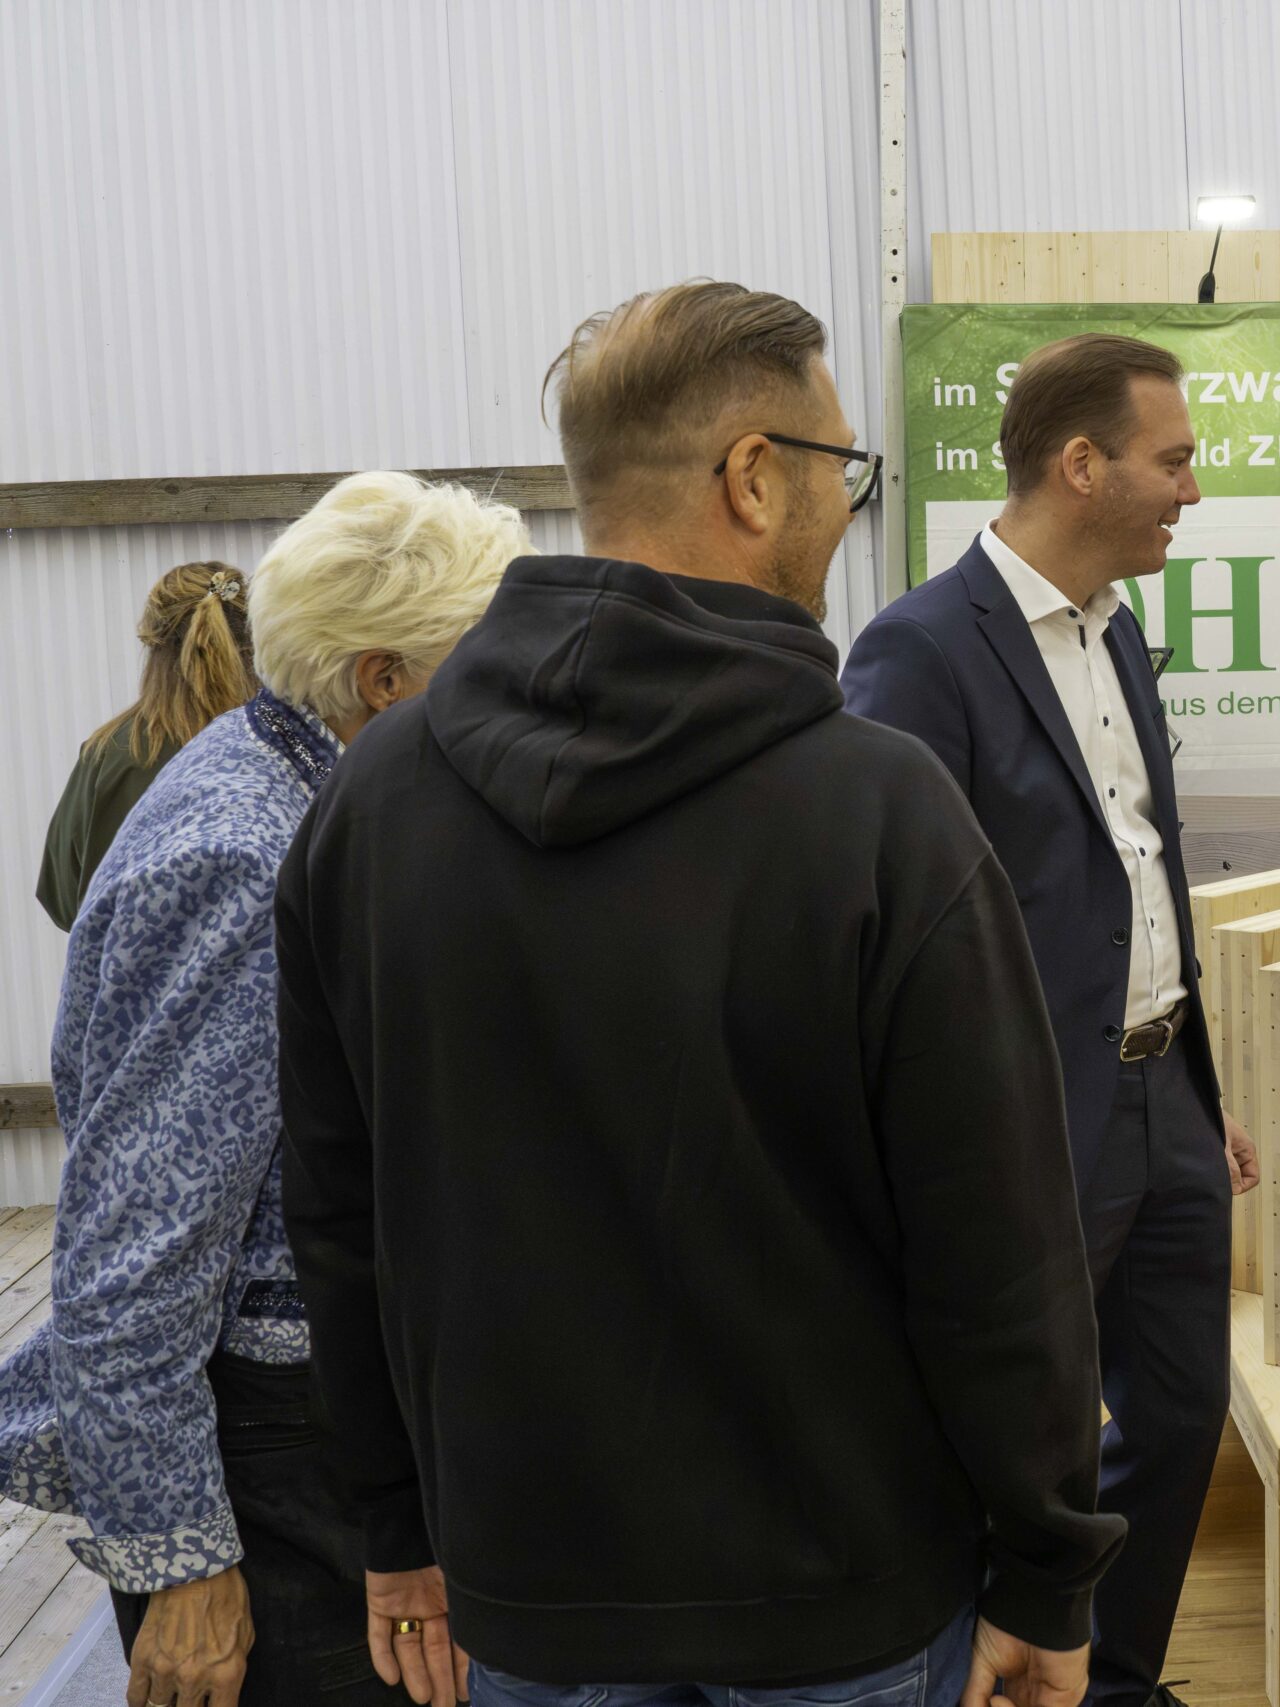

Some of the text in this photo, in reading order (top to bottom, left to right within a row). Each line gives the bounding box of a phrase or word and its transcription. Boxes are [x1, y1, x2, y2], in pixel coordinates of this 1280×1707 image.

[934, 377, 976, 406] im
[936, 442, 978, 471] im
[1160, 696, 1206, 717] us
